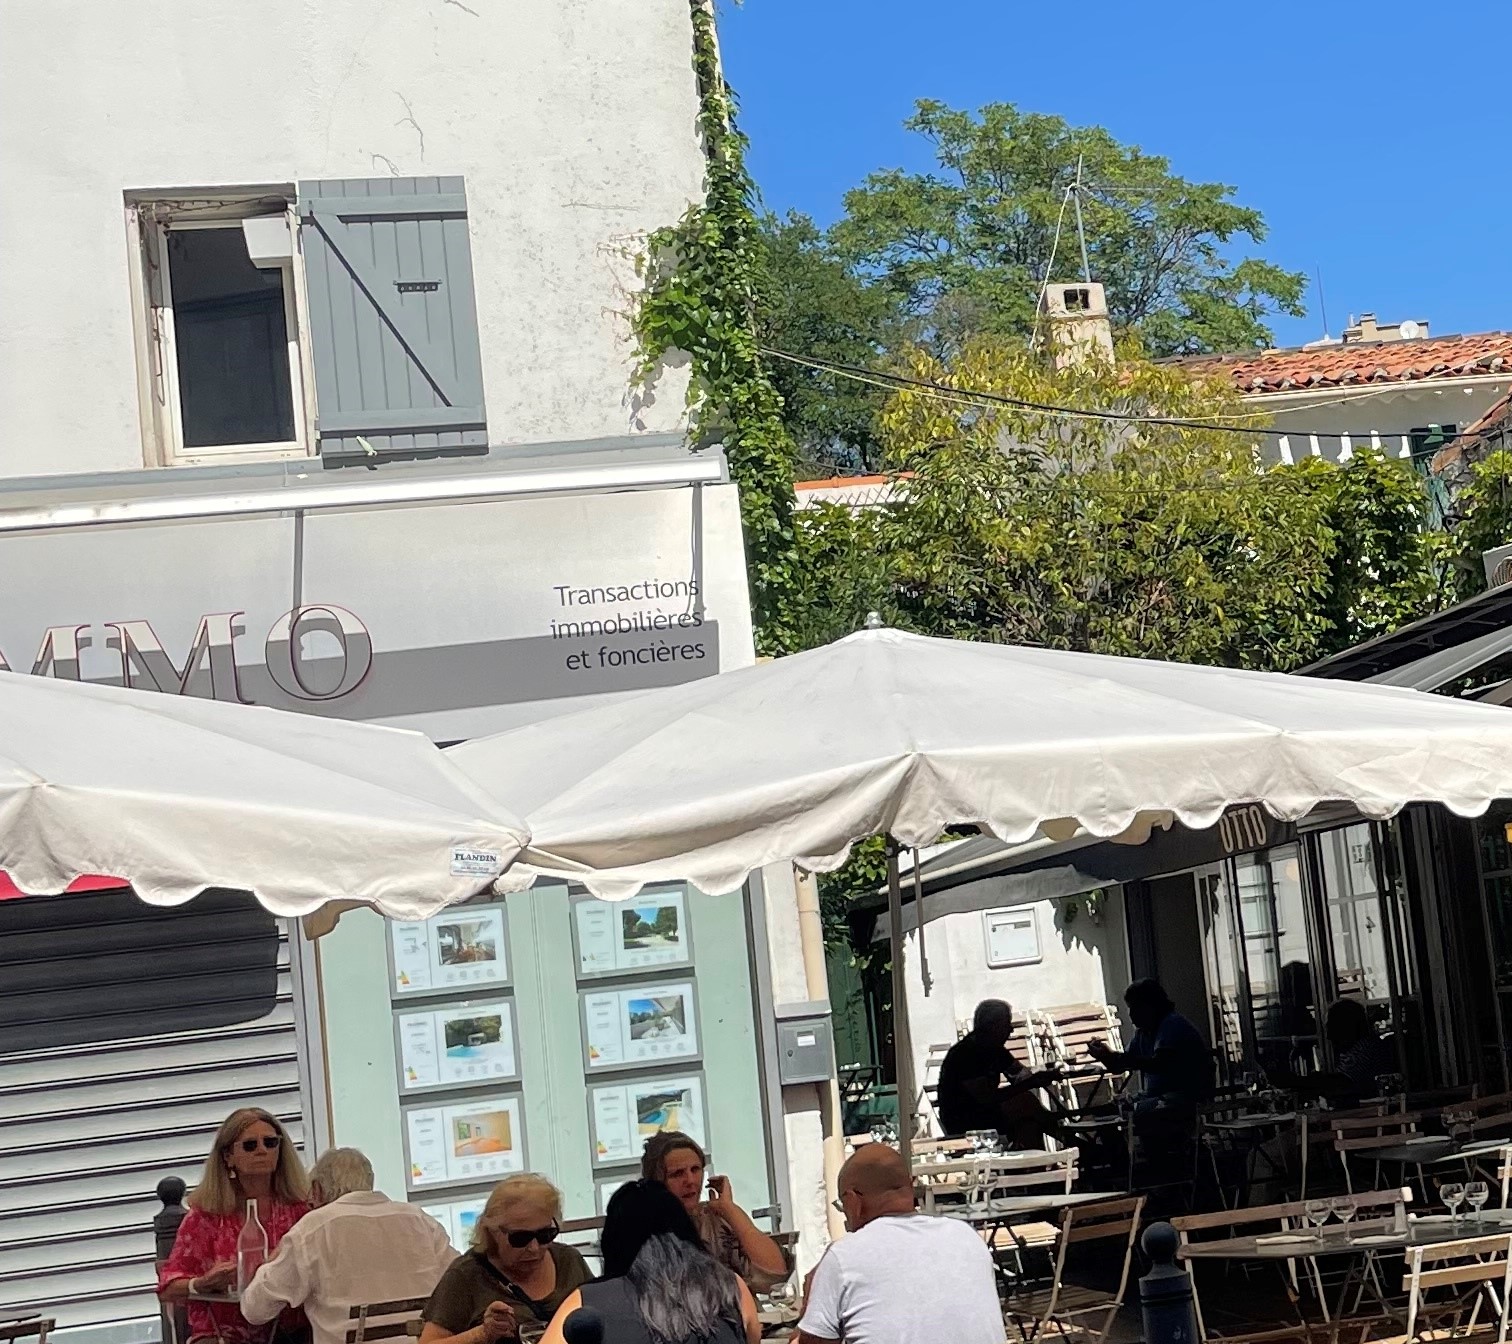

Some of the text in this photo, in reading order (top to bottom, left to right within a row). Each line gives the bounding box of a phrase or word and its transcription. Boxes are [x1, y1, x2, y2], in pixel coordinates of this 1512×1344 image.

[553, 578, 699, 607] Transactions
[550, 608, 703, 640] immobilières
[566, 640, 706, 671] et foncières
[1219, 805, 1267, 853] OTTO
